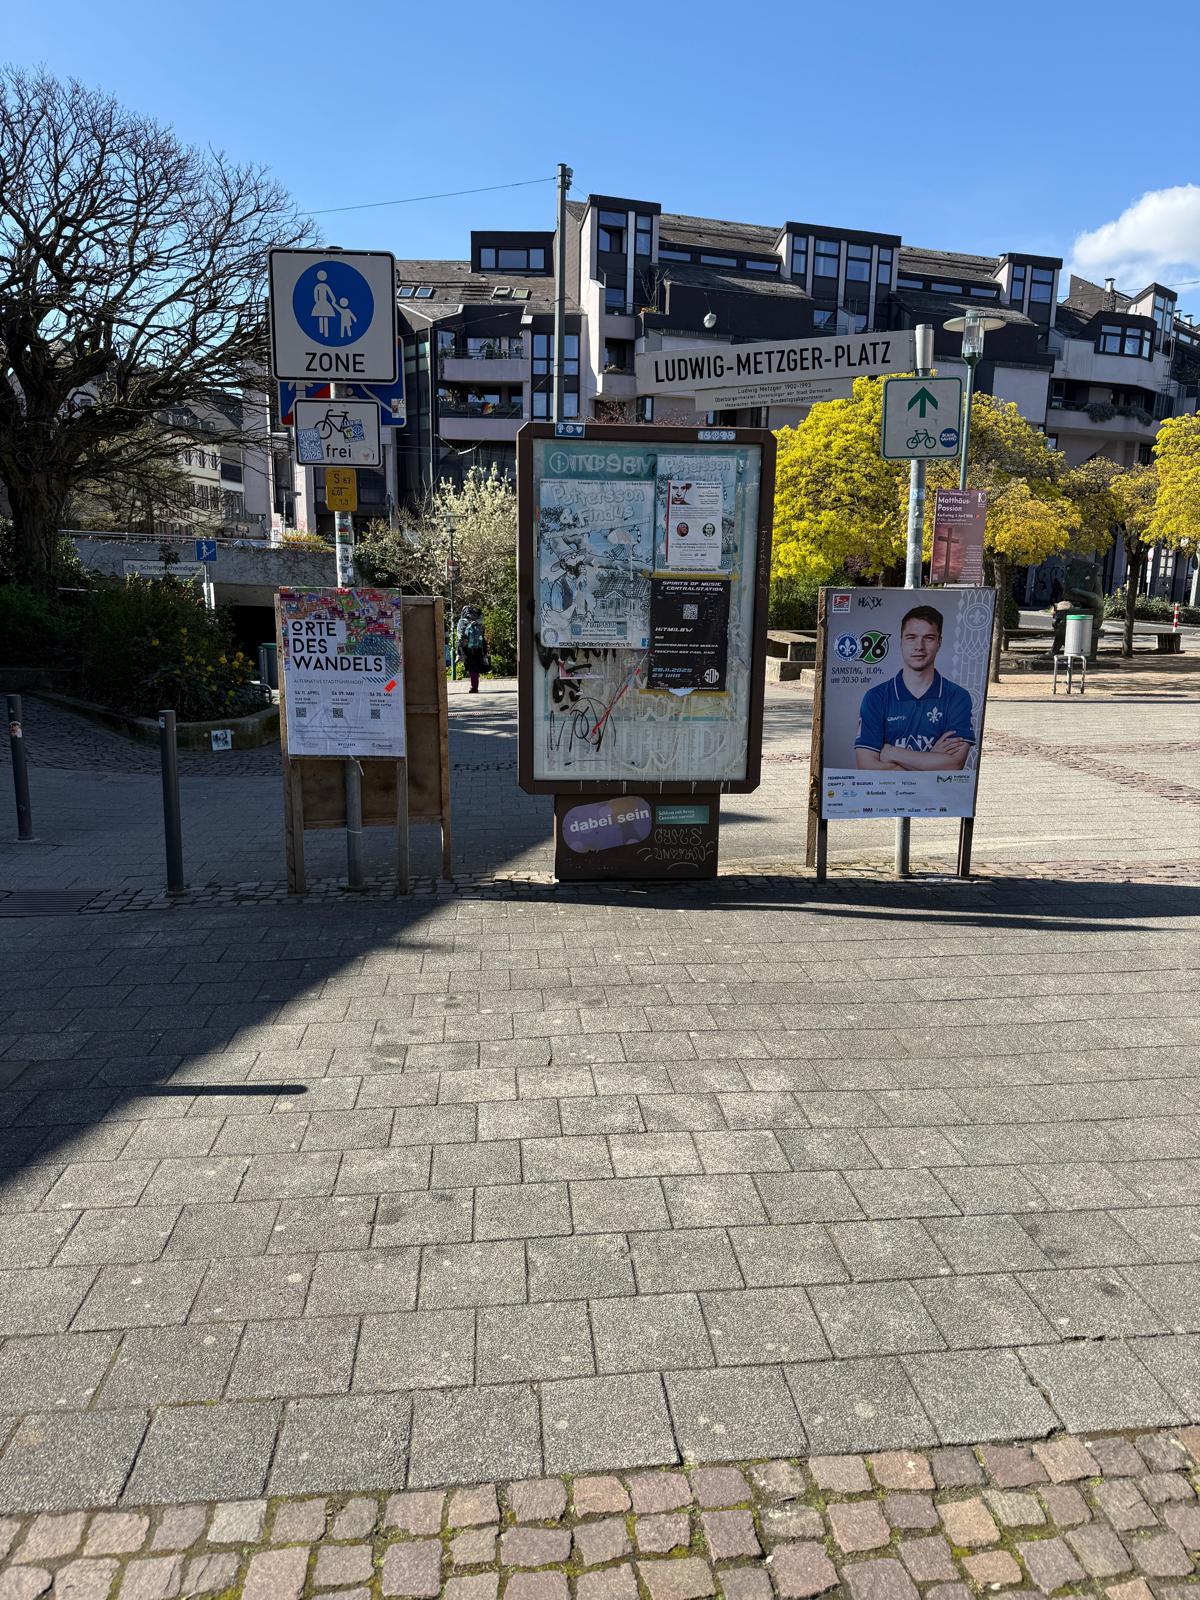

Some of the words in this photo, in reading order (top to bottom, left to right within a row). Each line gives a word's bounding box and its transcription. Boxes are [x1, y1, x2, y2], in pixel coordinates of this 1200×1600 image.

[305, 352, 365, 373] ZONE
[655, 341, 891, 383] LUDWIG-METZGER-PLATZ
[326, 444, 352, 458] frei
[333, 473, 340, 483] S
[551, 485, 646, 506] Pettersson
[938, 496, 970, 504] Matthäus-
[561, 508, 573, 523] &
[576, 506, 634, 527] Findus
[292, 620, 336, 635] ORTE
[293, 638, 328, 654] DES
[859, 634, 891, 661] 96
[292, 655, 383, 672] WANDELS
[831, 667, 863, 675] SAMSTAG,
[570, 814, 613, 832] dabei
[617, 808, 649, 823] sein
